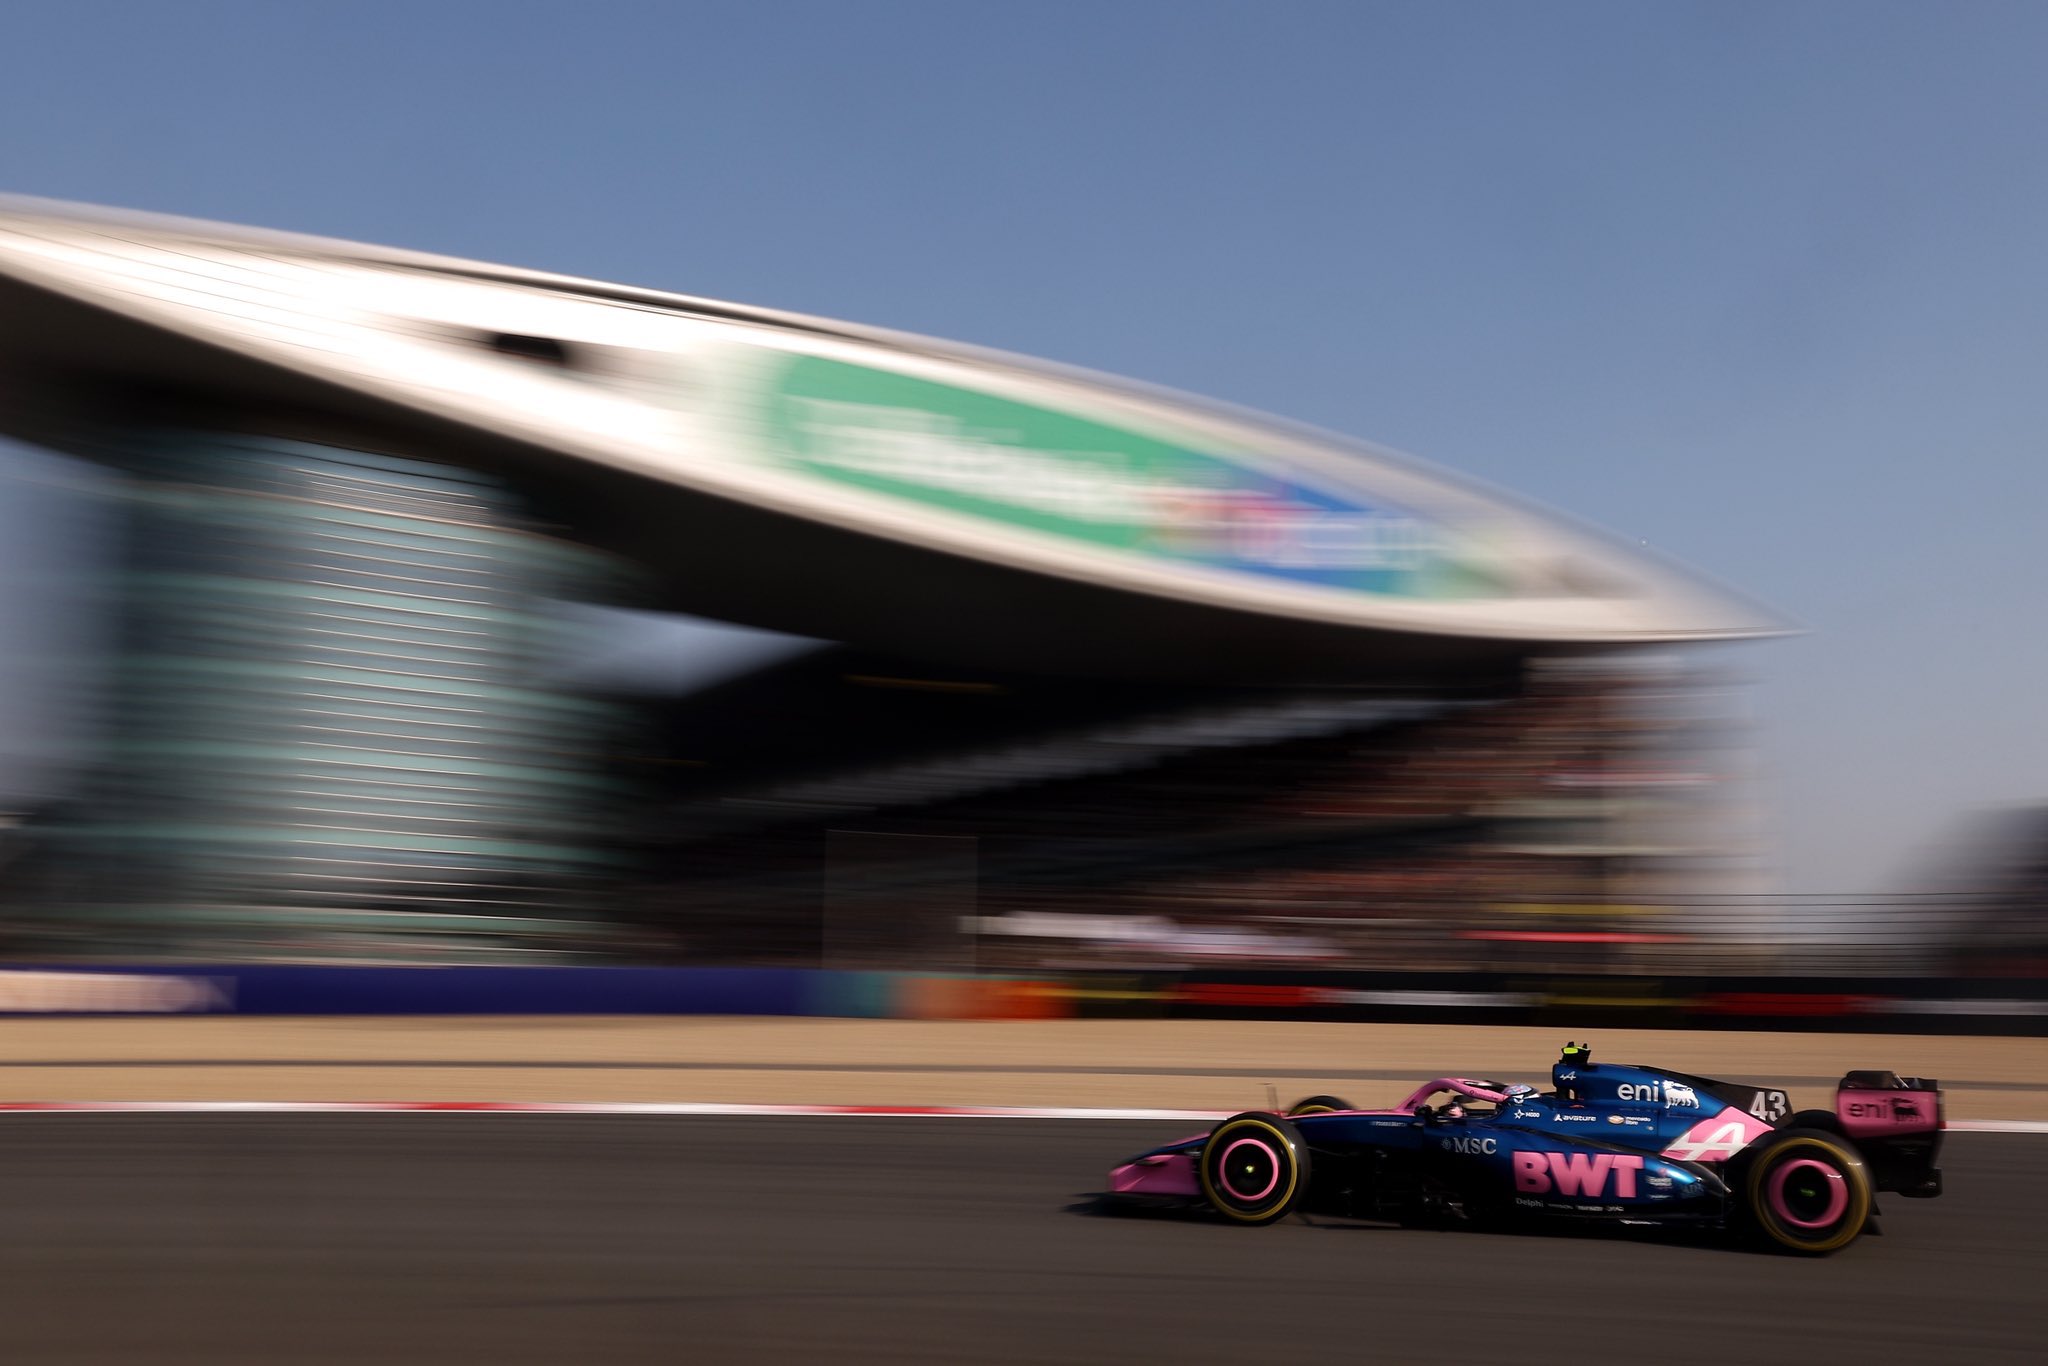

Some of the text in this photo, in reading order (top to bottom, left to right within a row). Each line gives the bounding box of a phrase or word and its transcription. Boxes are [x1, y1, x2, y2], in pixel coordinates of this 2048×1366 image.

[1617, 1080, 1659, 1102] eni
[1750, 1090, 1786, 1122] 43
[1848, 1098, 1888, 1120] eni
[1562, 1114, 1597, 1122] avature
[1453, 1137, 1497, 1155] MSC
[1512, 1151, 1644, 1198] BWT
[1515, 1197, 1544, 1208] Delphi
